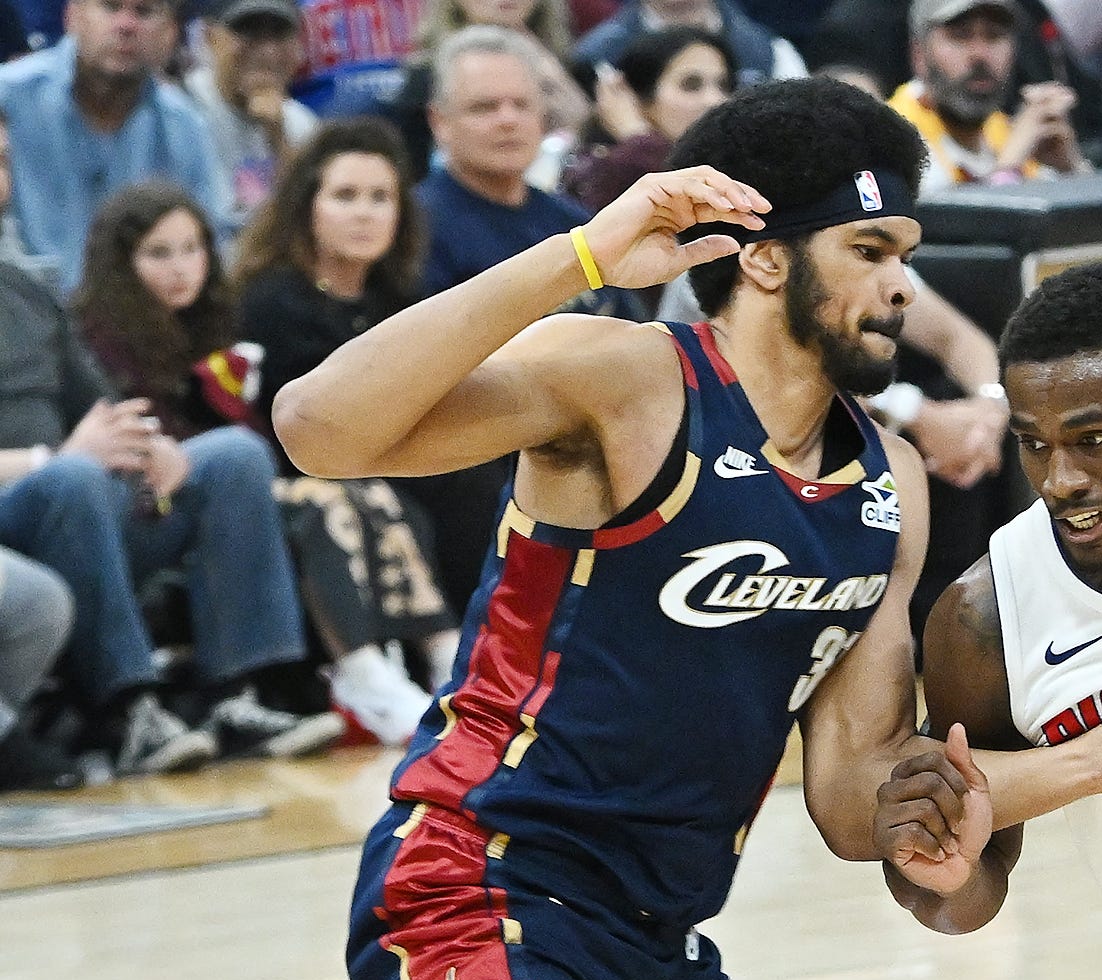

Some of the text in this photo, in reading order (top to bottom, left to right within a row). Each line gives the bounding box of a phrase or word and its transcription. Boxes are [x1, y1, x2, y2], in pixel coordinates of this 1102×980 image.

[865, 507, 901, 527] CLIFF
[658, 540, 888, 628] CLEVELAND
[787, 625, 863, 713] 3
